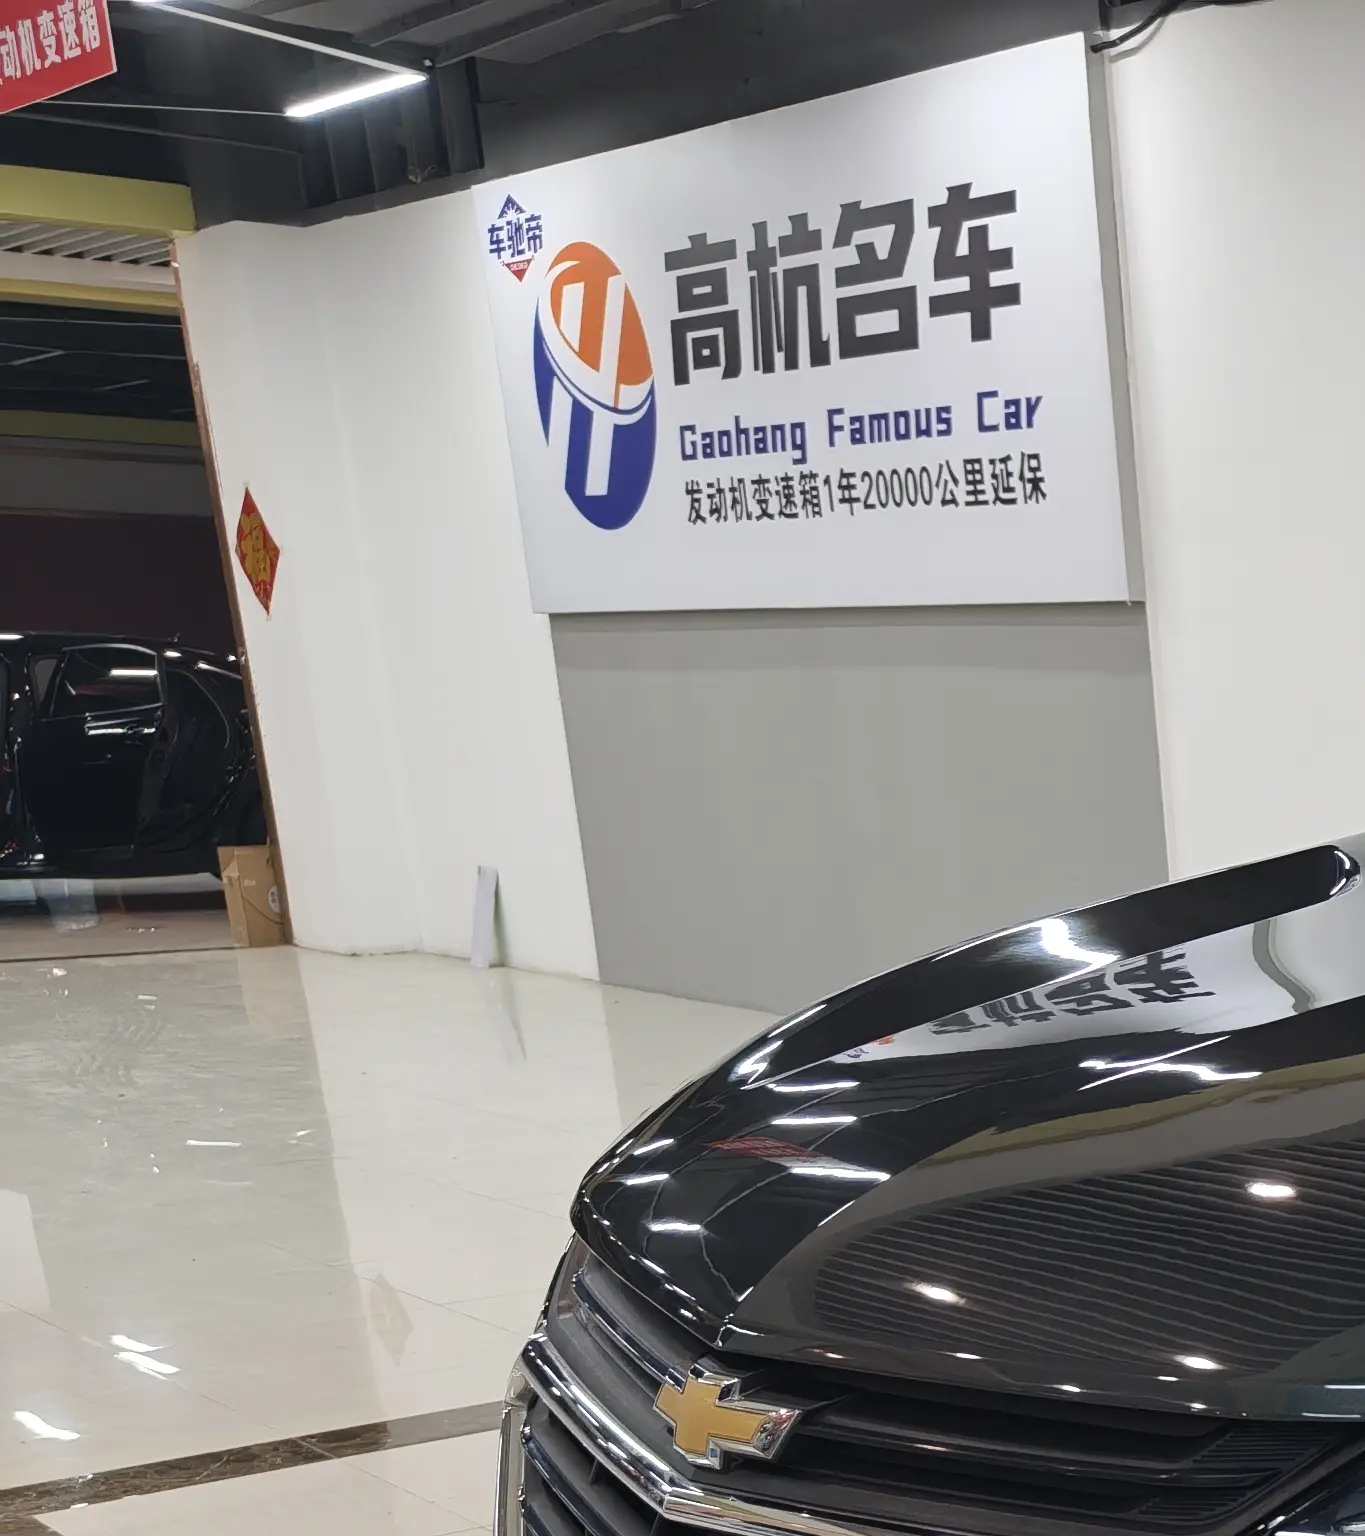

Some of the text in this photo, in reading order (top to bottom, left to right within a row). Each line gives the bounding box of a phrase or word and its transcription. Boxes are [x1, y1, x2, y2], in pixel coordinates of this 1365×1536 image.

[0, 0, 100, 84] 动机变速箱
[664, 182, 1021, 386] 高杭名车
[680, 390, 1043, 465] Gaohang Famous Car
[685, 451, 1047, 526] 发动机变速箱1年20000公里延保
